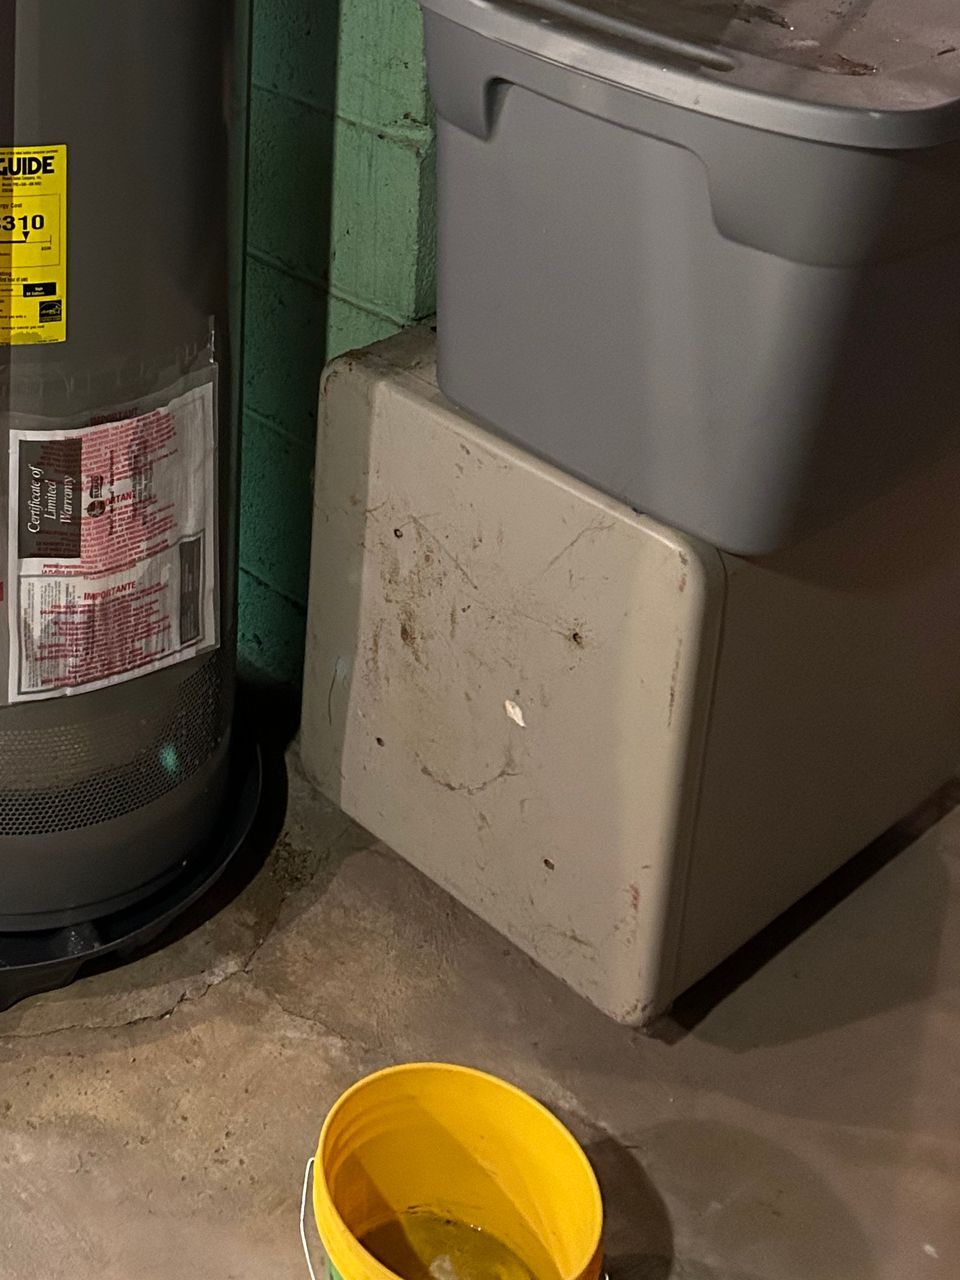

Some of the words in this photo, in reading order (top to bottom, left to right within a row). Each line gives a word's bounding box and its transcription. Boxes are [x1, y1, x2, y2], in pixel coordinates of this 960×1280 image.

[30, 463, 45, 477] of
[28, 479, 44, 533] Certificate
[44, 479, 58, 520] Limited
[83, 580, 136, 601] IMPORTANTE
